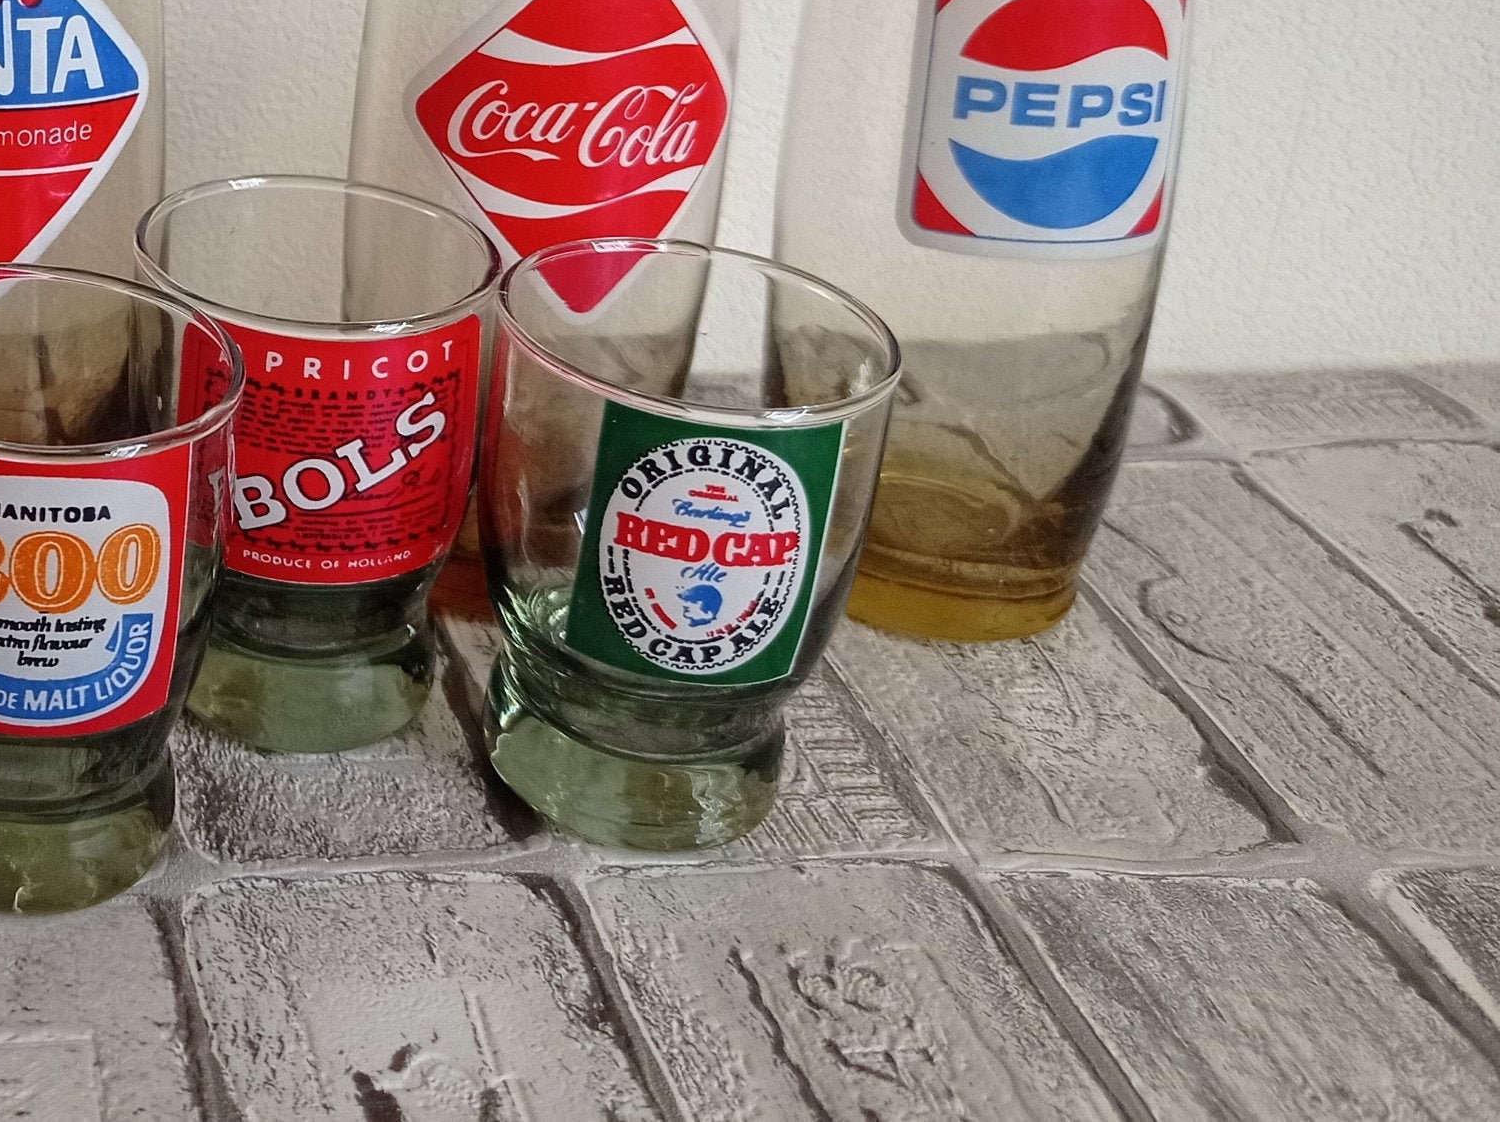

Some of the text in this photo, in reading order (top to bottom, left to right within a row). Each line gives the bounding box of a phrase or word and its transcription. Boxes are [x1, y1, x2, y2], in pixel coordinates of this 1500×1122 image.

[446, 79, 708, 168] Coca-Cola
[952, 75, 1167, 128] PEPSI
[208, 391, 446, 530] BOLS
[620, 444, 791, 521] ORIGINAL
[243, 549, 412, 570] PRODUCE OF HOLLAND
[613, 511, 711, 563] RED
[680, 562, 728, 583] Ale
[603, 574, 648, 640] RED
[648, 637, 722, 665] CAP
[729, 596, 781, 655] ALE
[17, 651, 60, 667] brew
[23, 684, 87, 712] MALT
[95, 621, 151, 701] LIQUOR
